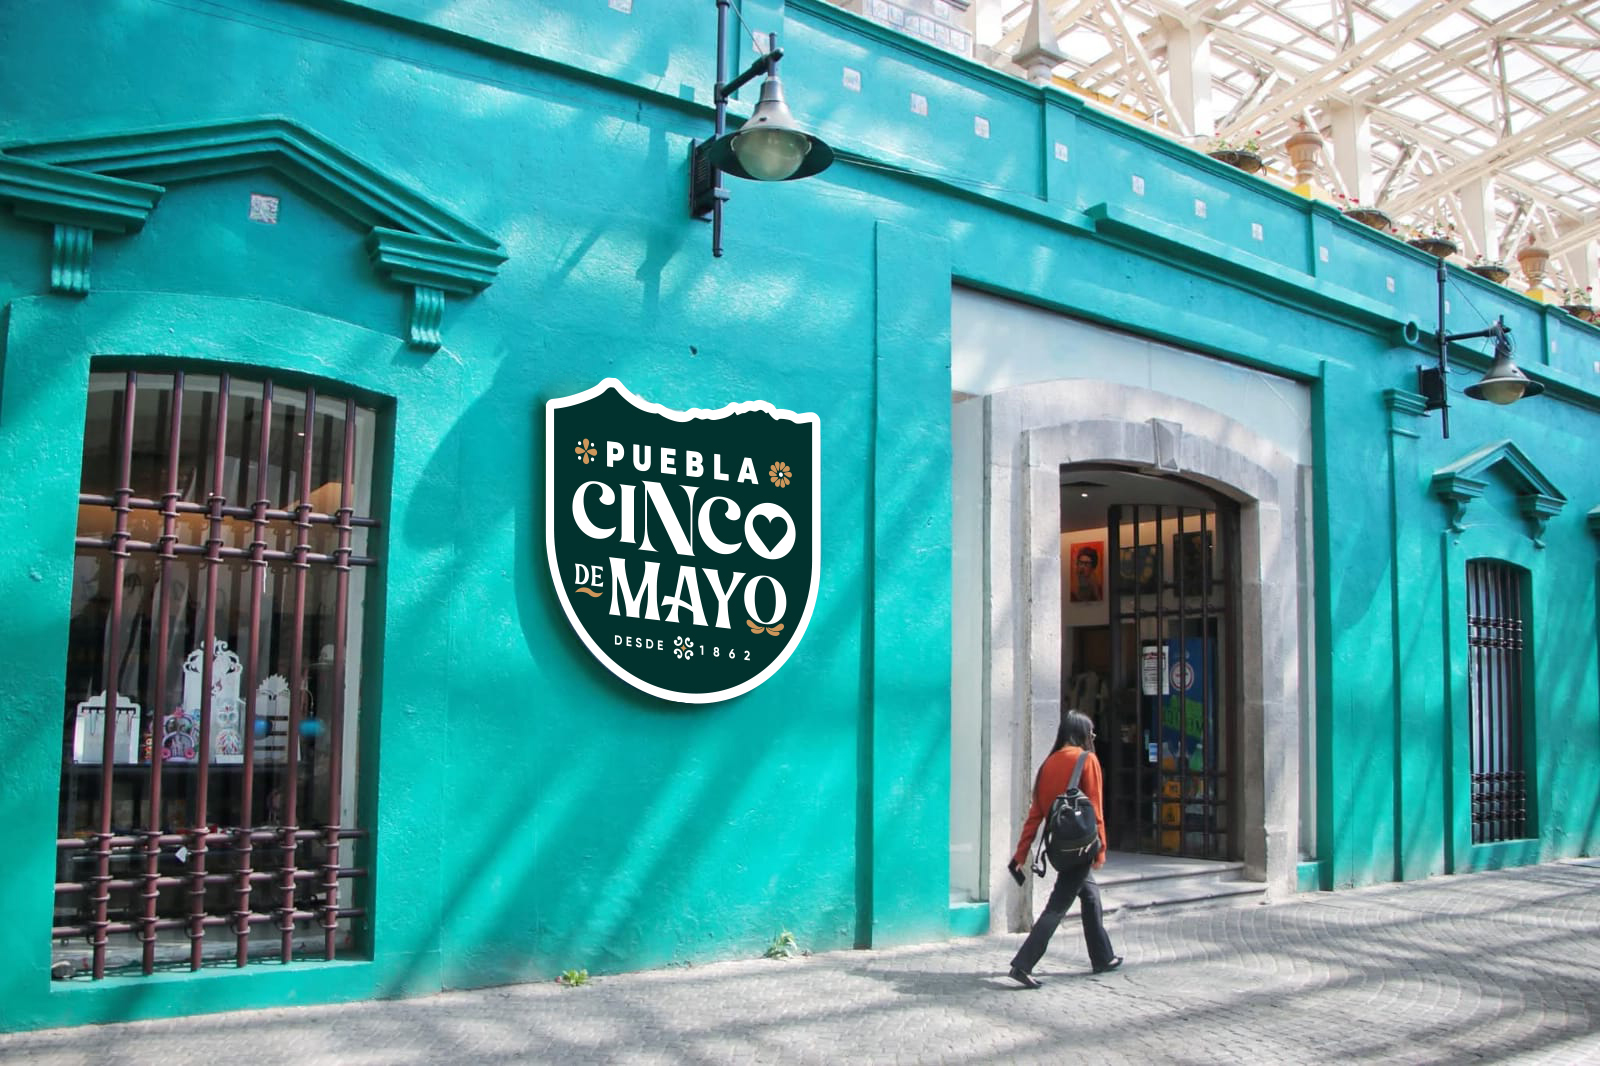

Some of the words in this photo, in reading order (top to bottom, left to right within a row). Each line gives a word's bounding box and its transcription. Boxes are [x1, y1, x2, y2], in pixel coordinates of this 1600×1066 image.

[606, 440, 759, 485] PUEBLA
[572, 480, 797, 560] CINCO
[574, 563, 604, 588] DE
[608, 556, 788, 630] MAYO
[614, 634, 664, 651] DESDE
[699, 644, 751, 661] 1862
